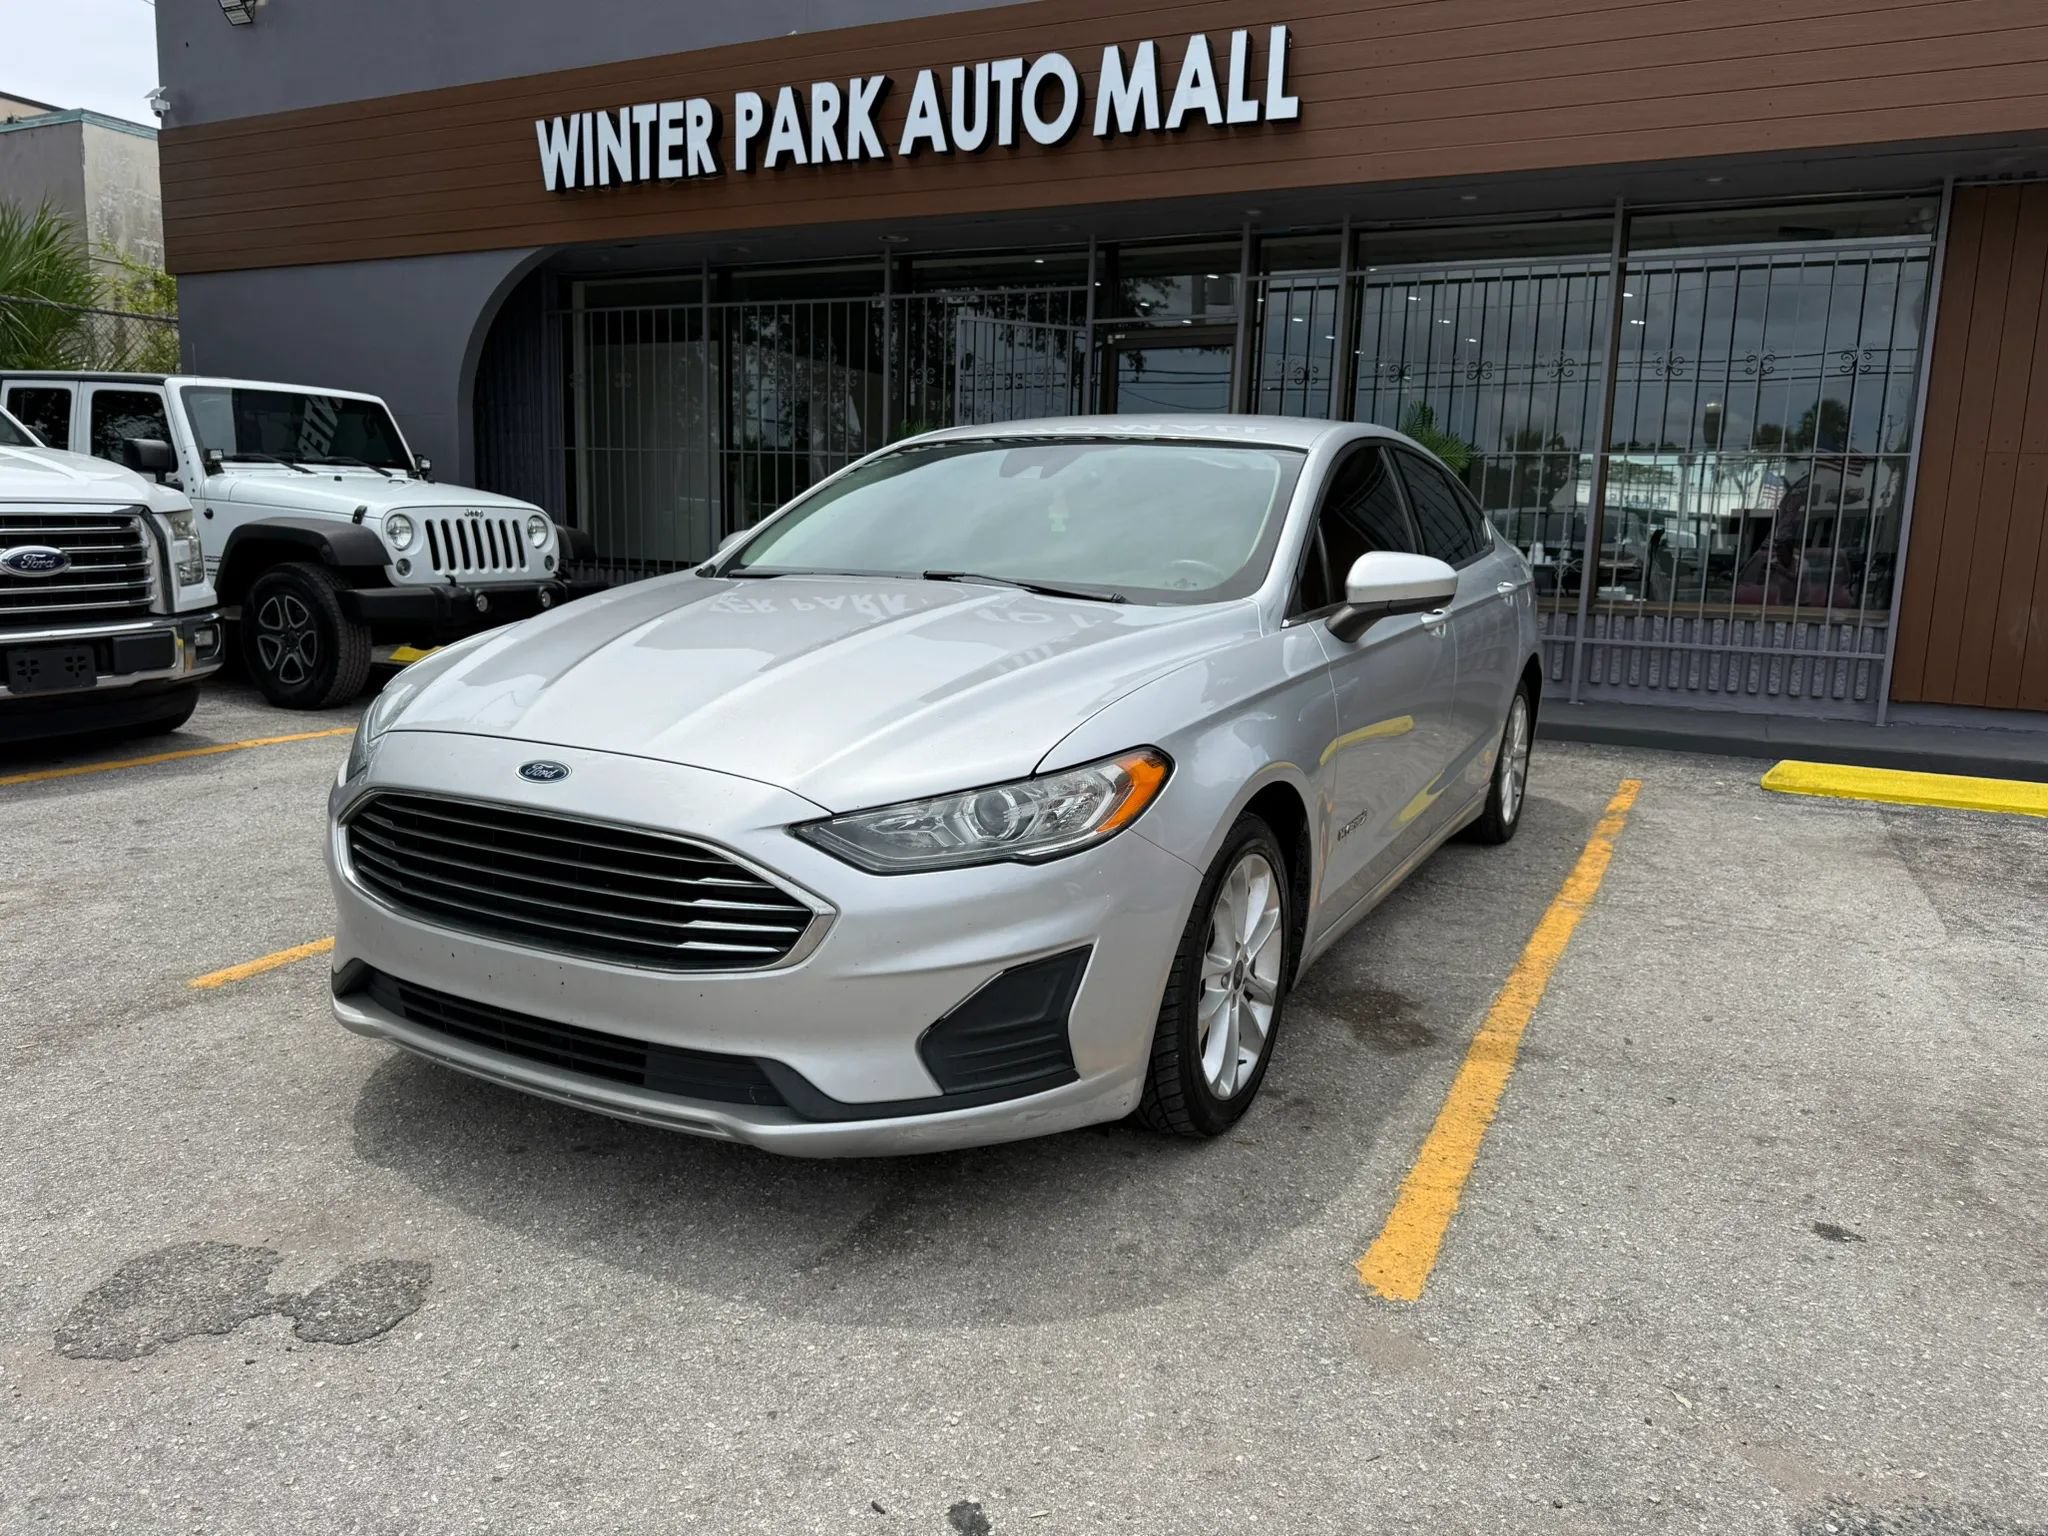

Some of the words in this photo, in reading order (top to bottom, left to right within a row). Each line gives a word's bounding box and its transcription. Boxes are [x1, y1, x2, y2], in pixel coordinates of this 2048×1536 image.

[535, 98, 717, 191] WINTER
[735, 75, 886, 171] PARK
[898, 52, 1080, 155] AUTO
[1093, 25, 1299, 136] MALL
[20, 553, 56, 569] Ford
[525, 763, 560, 779] Ford
